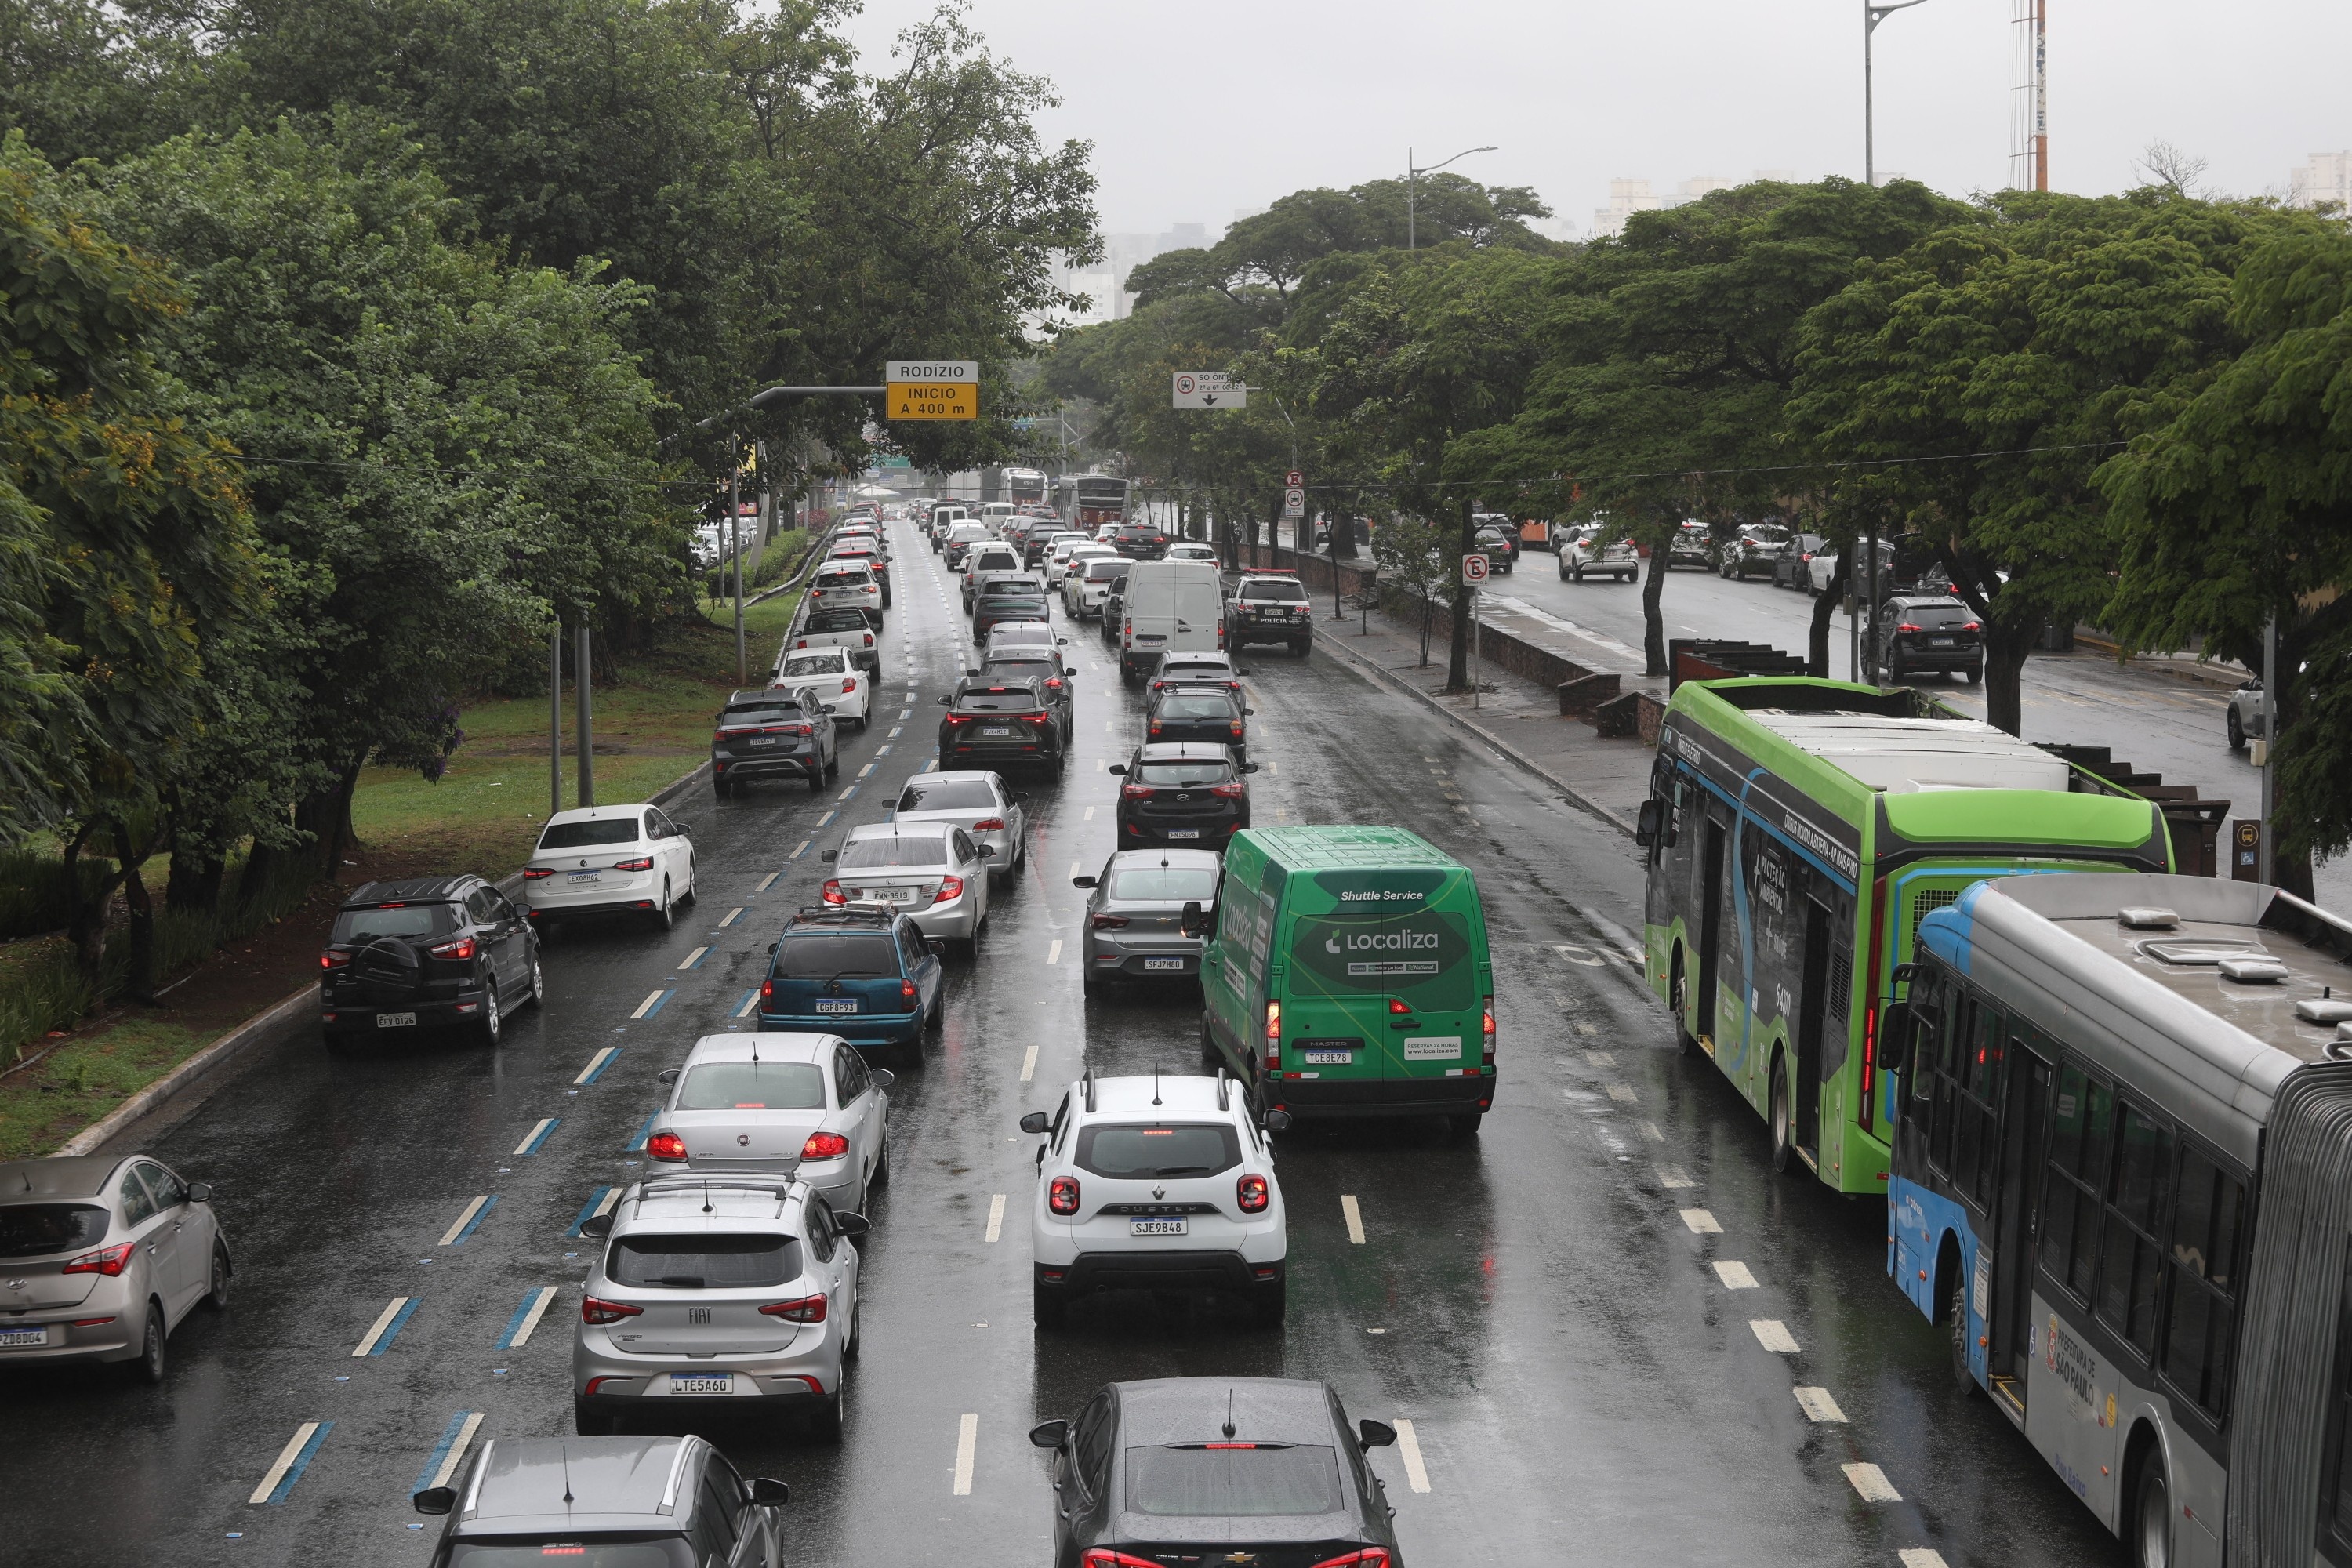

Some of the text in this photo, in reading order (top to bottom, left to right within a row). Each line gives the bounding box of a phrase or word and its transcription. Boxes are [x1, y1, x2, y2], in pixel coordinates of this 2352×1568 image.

[901, 364, 964, 377] RODÍZIO
[909, 386, 956, 398] INÍCIO
[901, 404, 964, 414] A 400 m
[1784, 813, 1797, 836] ÔNIBUS
[1796, 822, 1810, 844] MOVIDO
[1809, 832, 1813, 847] A
[1813, 833, 1829, 858] BATERIA
[1830, 846, 1837, 863] AR
[1836, 849, 1846, 870] MAIS
[1846, 856, 1857, 878] PURO
[1762, 855, 1785, 888] PROTEÇÃO
[1341, 891, 1423, 901] Shuttle Service
[1759, 881, 1783, 915] AMBIENTAL
[1347, 929, 1438, 949] Localiza
[1309, 1054, 1347, 1062] TCE8E78
[1135, 1222, 1181, 1233] SJE9B48
[689, 1307, 712, 1324] FIAT
[2058, 1329, 2096, 1378] PREFEITURA DE
[675, 1380, 727, 1392] LTE5A60
[2056, 1352, 2094, 1407] SÃO PAULO
